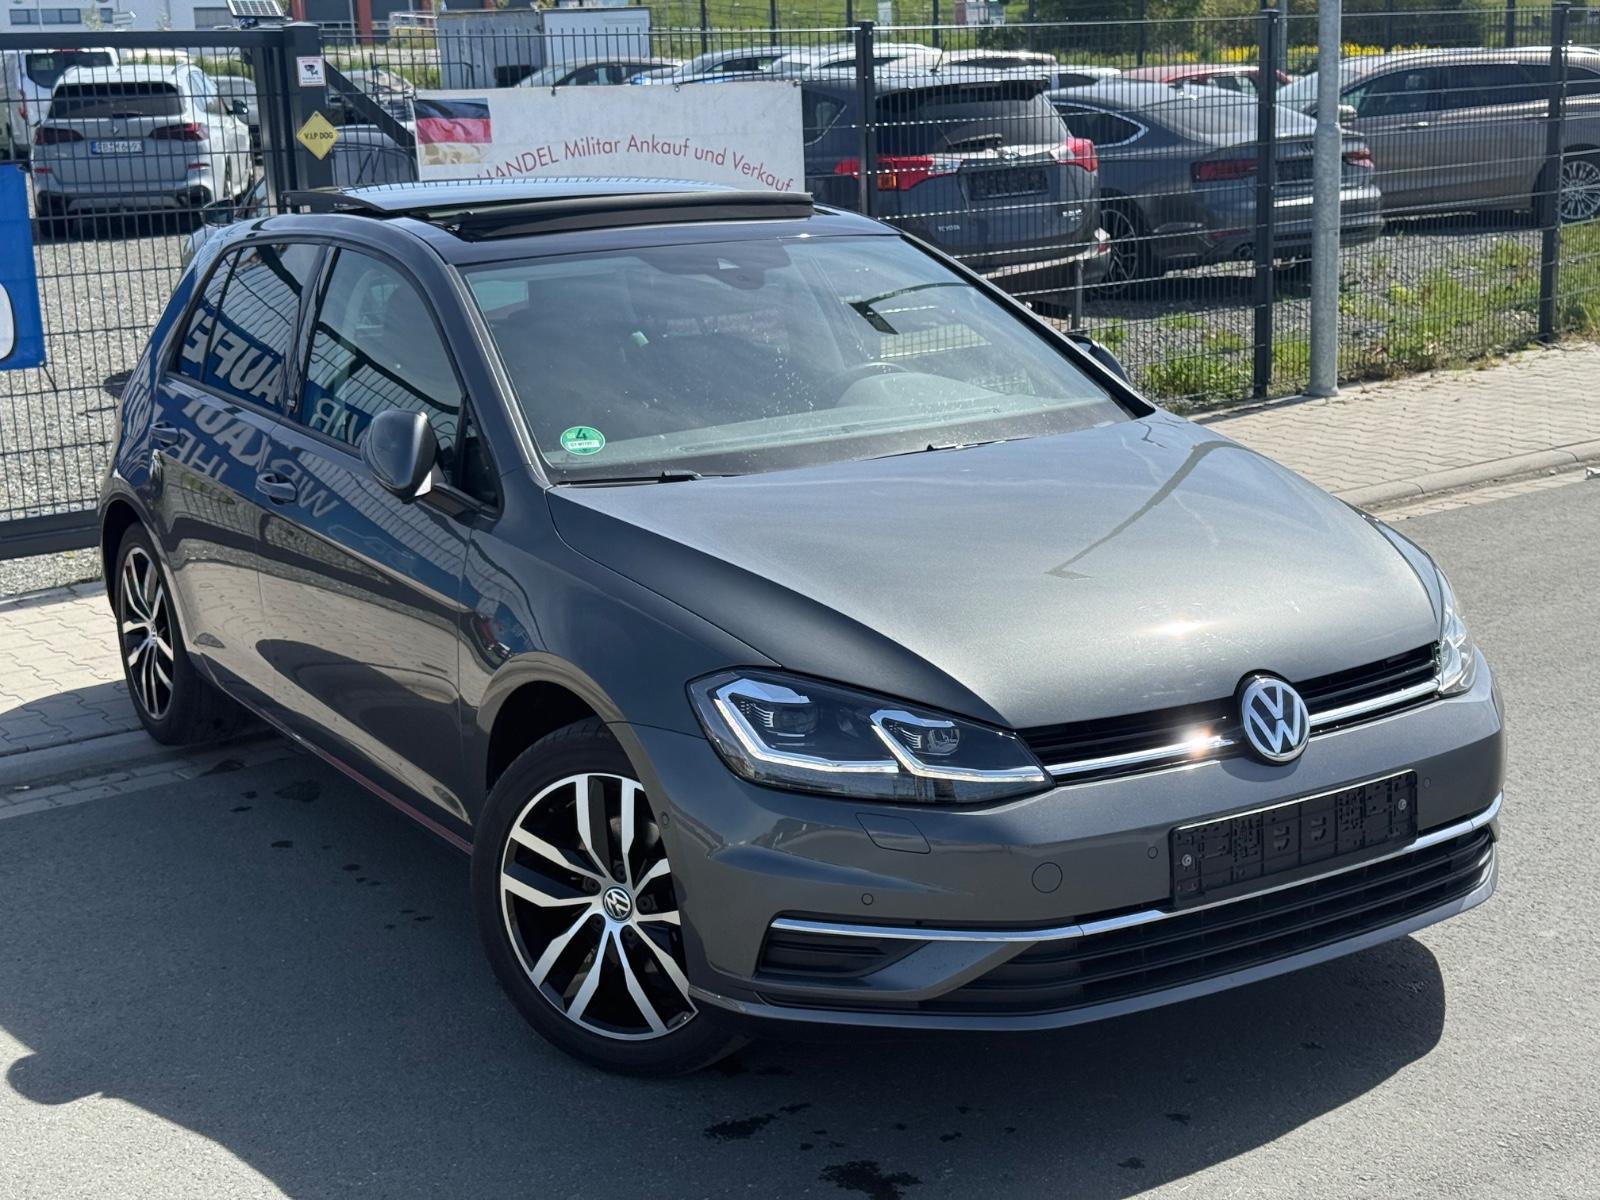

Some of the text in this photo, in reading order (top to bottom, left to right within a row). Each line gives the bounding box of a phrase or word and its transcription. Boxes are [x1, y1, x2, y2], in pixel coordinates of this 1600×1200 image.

[320, 131, 334, 140] DOG
[564, 135, 621, 160] Militar
[627, 133, 690, 157] Ankauf
[694, 147, 727, 166] und
[732, 151, 794, 192] Verkauf
[576, 428, 588, 441] 4
